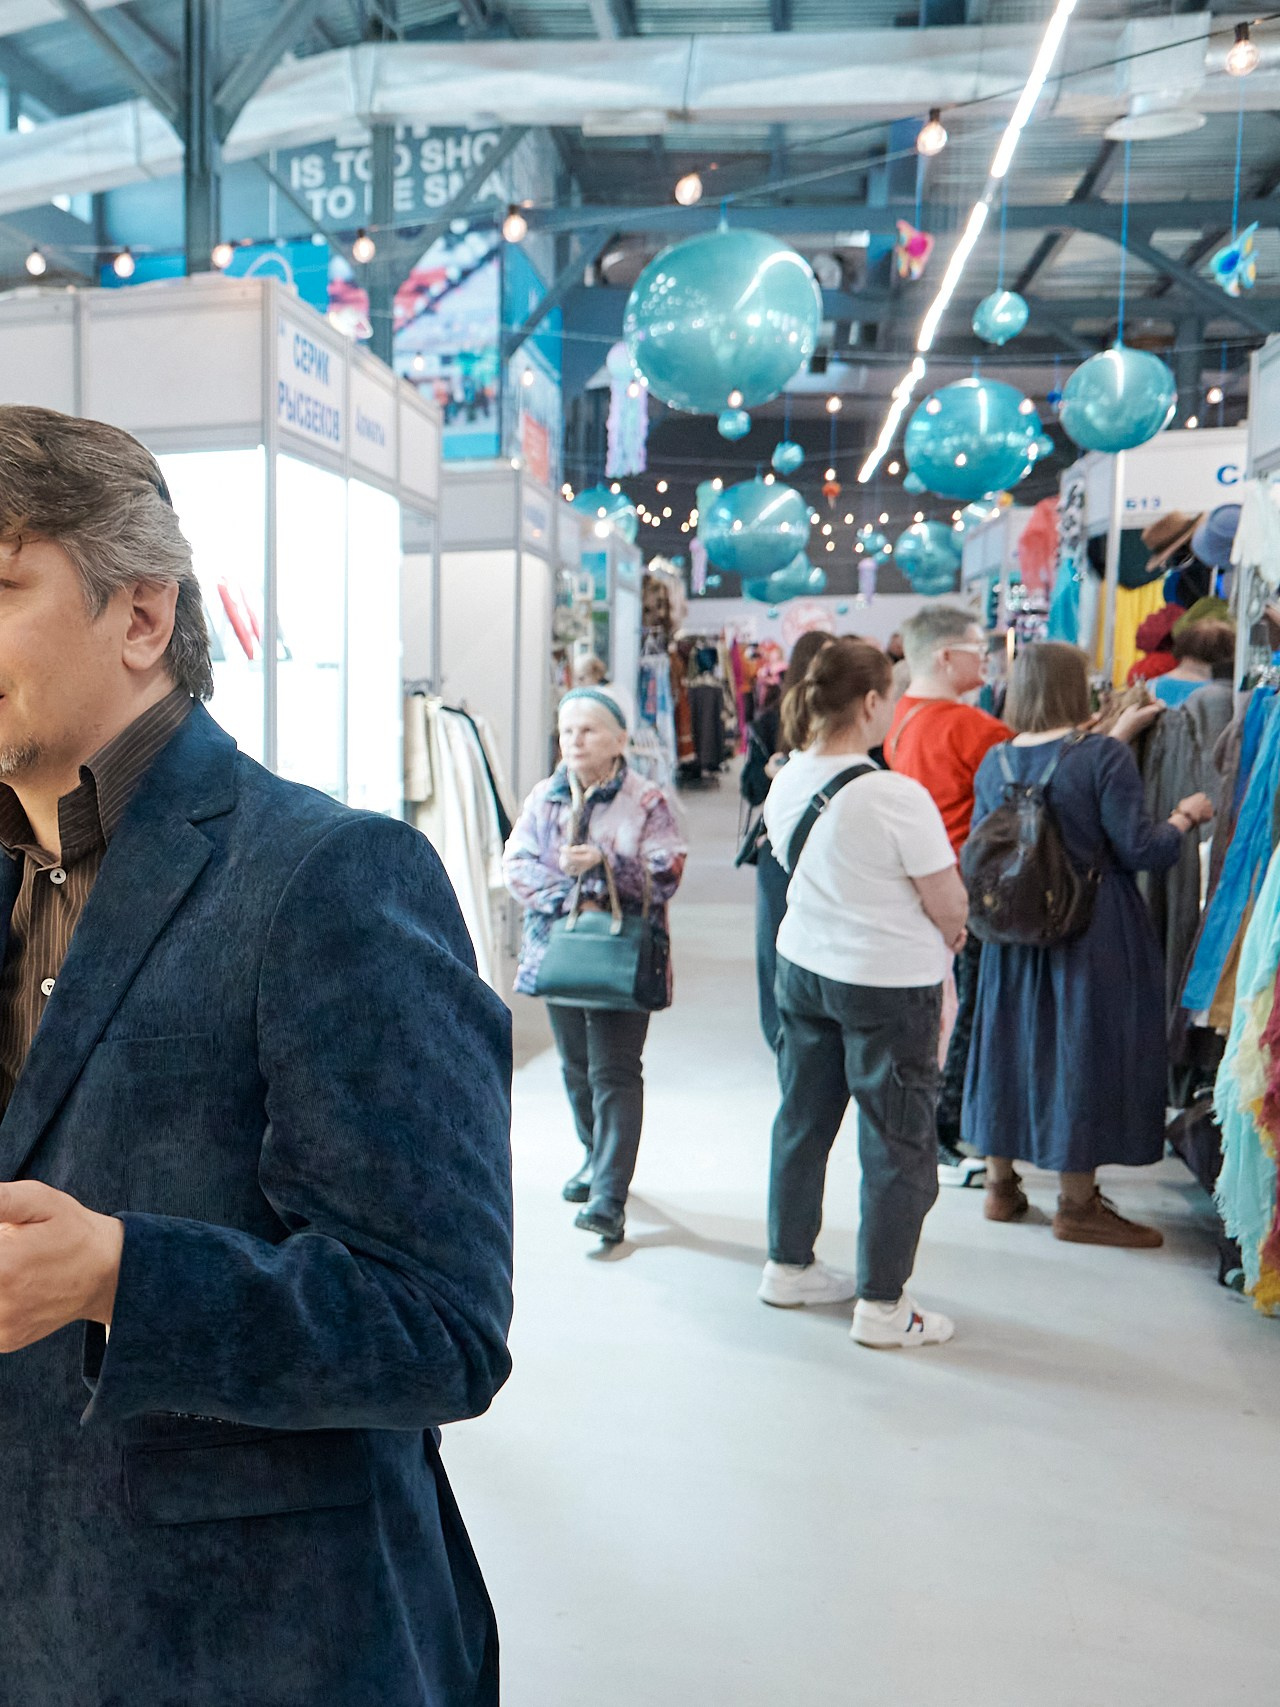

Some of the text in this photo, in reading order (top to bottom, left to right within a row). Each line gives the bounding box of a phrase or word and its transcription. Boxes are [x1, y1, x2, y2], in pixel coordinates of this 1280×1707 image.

[290, 154, 326, 191] IS
[305, 185, 356, 221] TO
[363, 176, 415, 212] E
